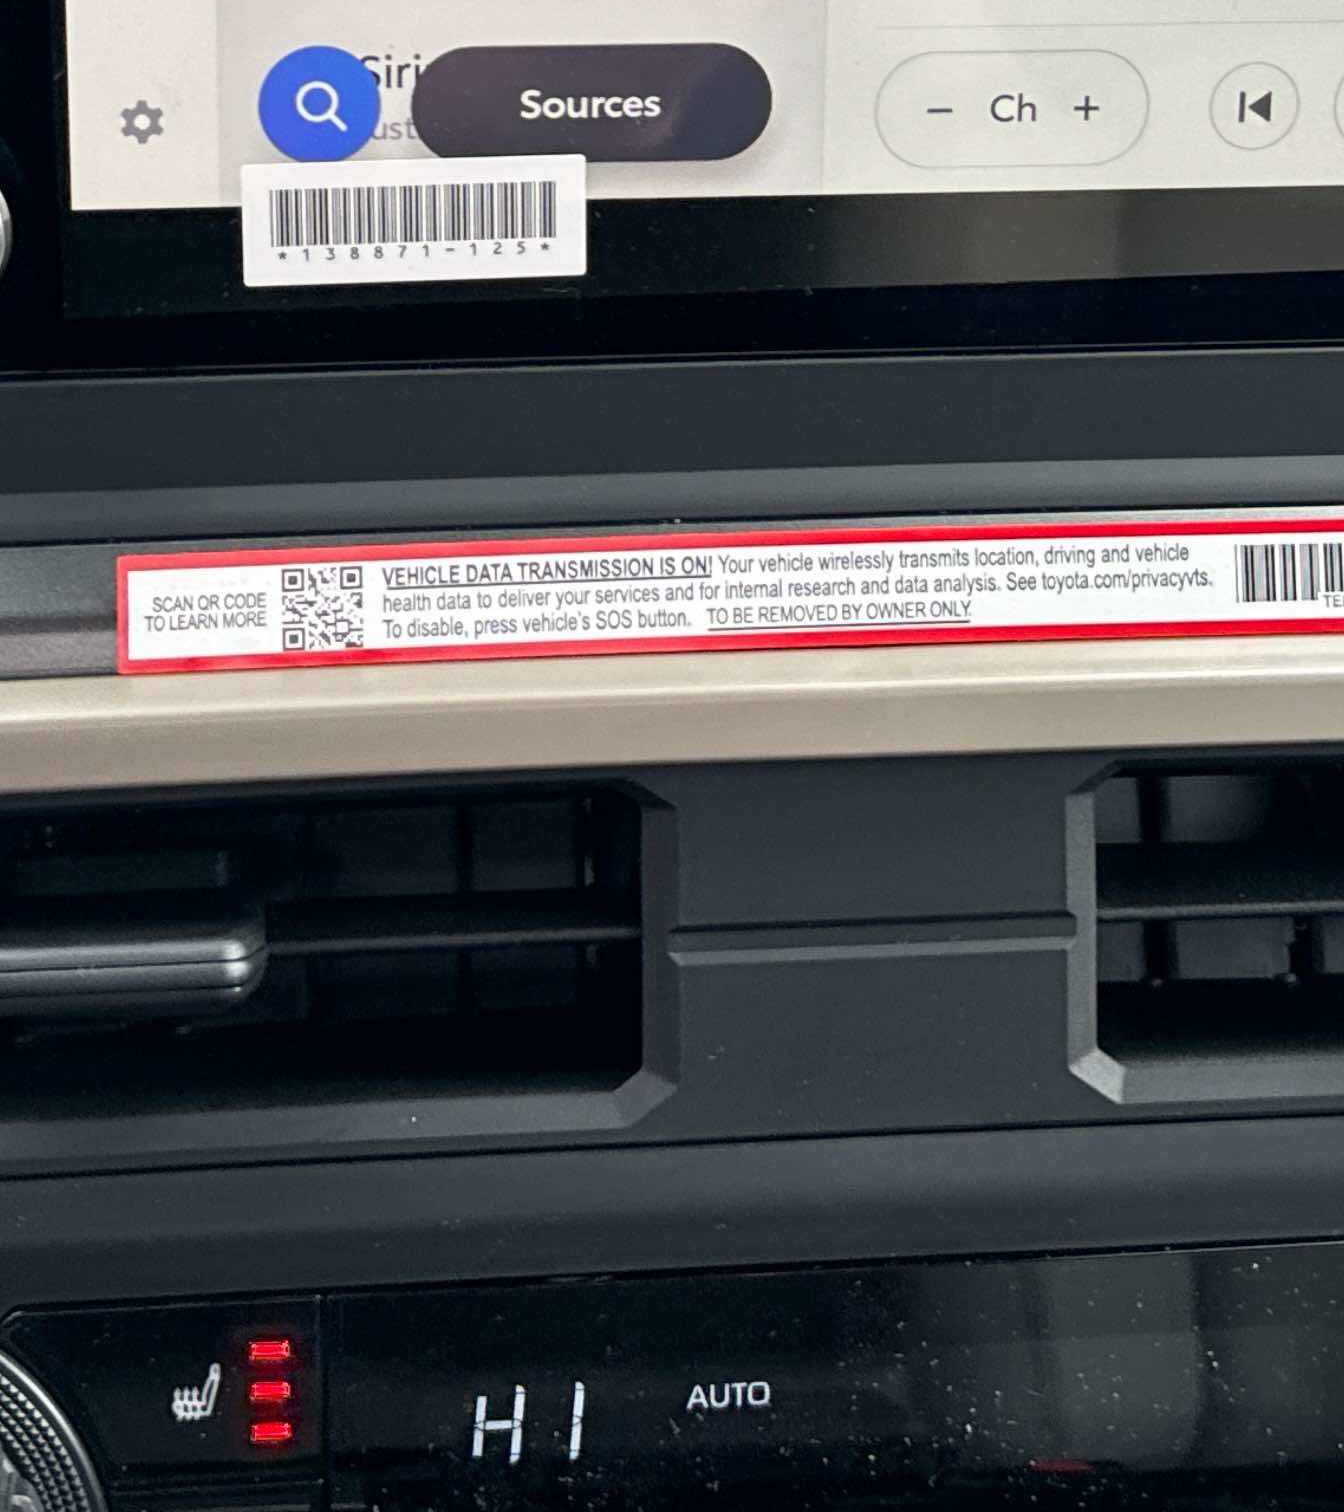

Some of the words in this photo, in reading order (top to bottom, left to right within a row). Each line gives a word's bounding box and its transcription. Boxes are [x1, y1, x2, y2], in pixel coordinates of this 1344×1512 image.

[520, 89, 661, 120] Sources
[990, 92, 1038, 124] Ch
[382, 564, 461, 586] VEHICLE
[466, 563, 513, 582] DATA
[517, 557, 654, 580] TRANSMISSION
[660, 556, 676, 575] IS
[718, 554, 754, 574] Your
[759, 552, 813, 572] vehicle
[818, 550, 894, 573] wirelessly
[899, 548, 970, 568] transmits
[975, 547, 1039, 567] location,
[1044, 545, 1095, 568] driving
[1101, 543, 1129, 563] and
[1135, 542, 1189, 562] vehicle
[152, 595, 194, 613] SCAN
[223, 592, 267, 609] CODE
[383, 592, 431, 612] health
[437, 591, 471, 610] data
[477, 591, 492, 608] to
[498, 588, 551, 607] deliver
[556, 589, 590, 610] your
[595, 585, 660, 604] services
[665, 582, 693, 600] and
[699, 582, 720, 600] for
[725, 578, 782, 599] internal
[788, 577, 855, 597] research
[861, 575, 889, 595] and
[895, 574, 928, 593] data
[934, 572, 1001, 596] analysis.
[1006, 571, 1036, 591] See
[144, 615, 166, 632] TO
[169, 613, 218, 630] LEARN
[223, 610, 267, 628] MORE
[382, 619, 402, 638] To
[408, 616, 468, 638] disable,
[474, 617, 517, 639] press
[523, 611, 590, 633] vehicle's
[596, 609, 632, 630] SOS
[638, 609, 692, 628] button.
[706, 607, 728, 624] TO
[733, 606, 753, 623] BE
[758, 604, 837, 622] REMOVED
[842, 603, 863, 620] BY
[866, 601, 926, 619] OWNER
[686, 1381, 771, 1410] AUTO
